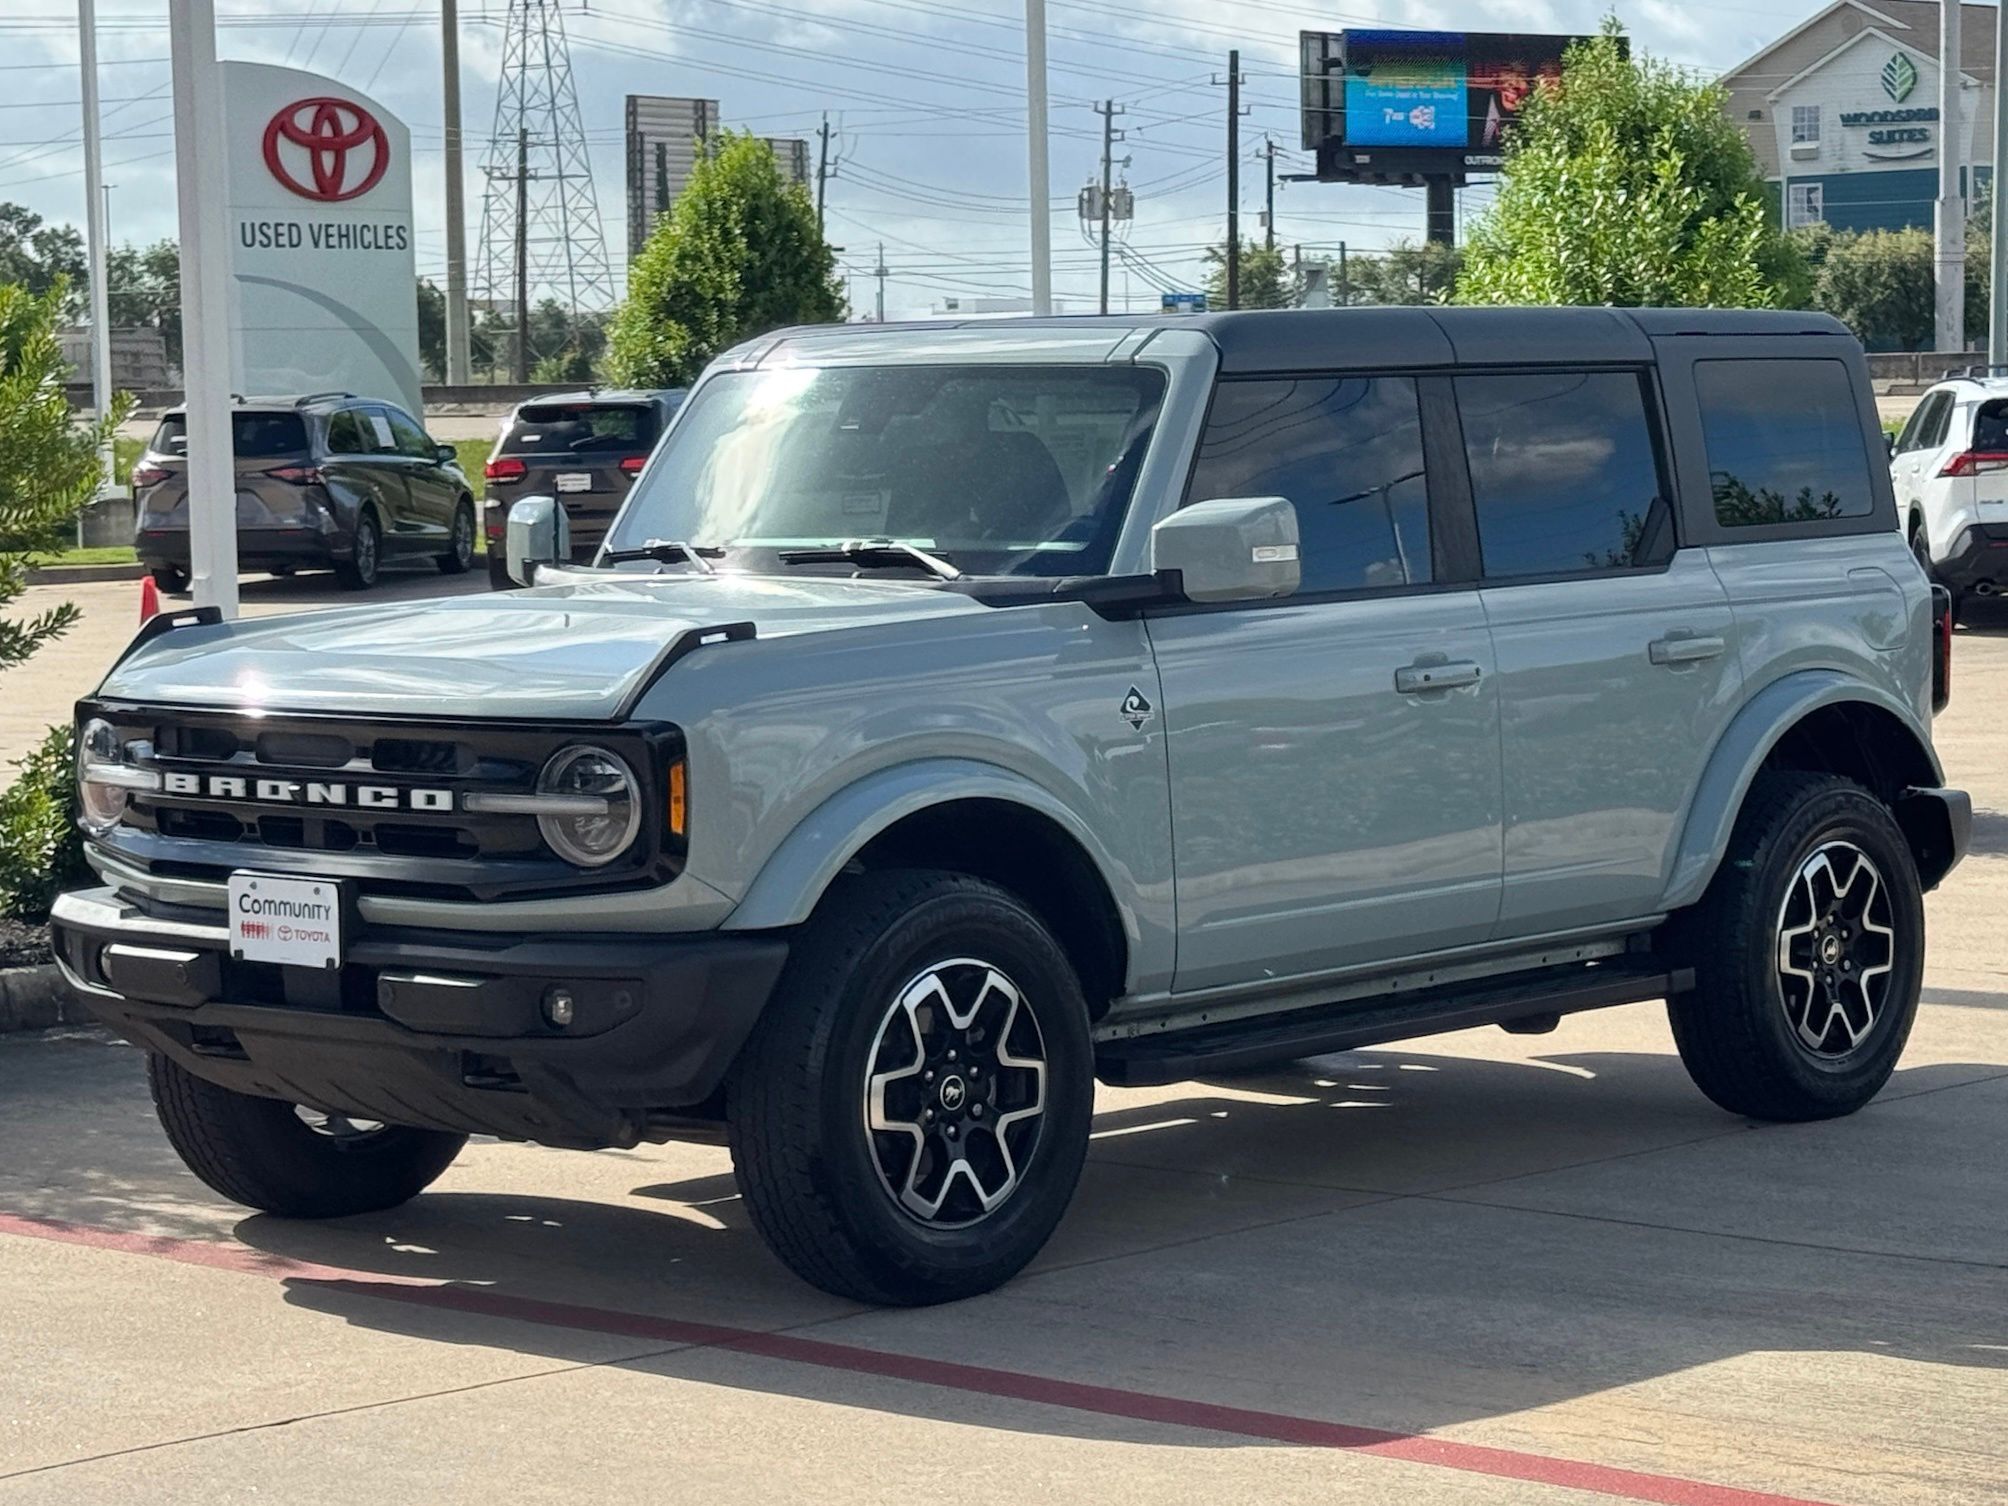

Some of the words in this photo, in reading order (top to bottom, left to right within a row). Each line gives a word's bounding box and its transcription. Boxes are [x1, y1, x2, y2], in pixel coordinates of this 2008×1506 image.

[1868, 128, 1930, 145] SUITES
[241, 222, 301, 248] USED
[309, 223, 408, 250] VEHICLES
[164, 772, 453, 811] BRONCO
[294, 929, 331, 943] TOYOTA
